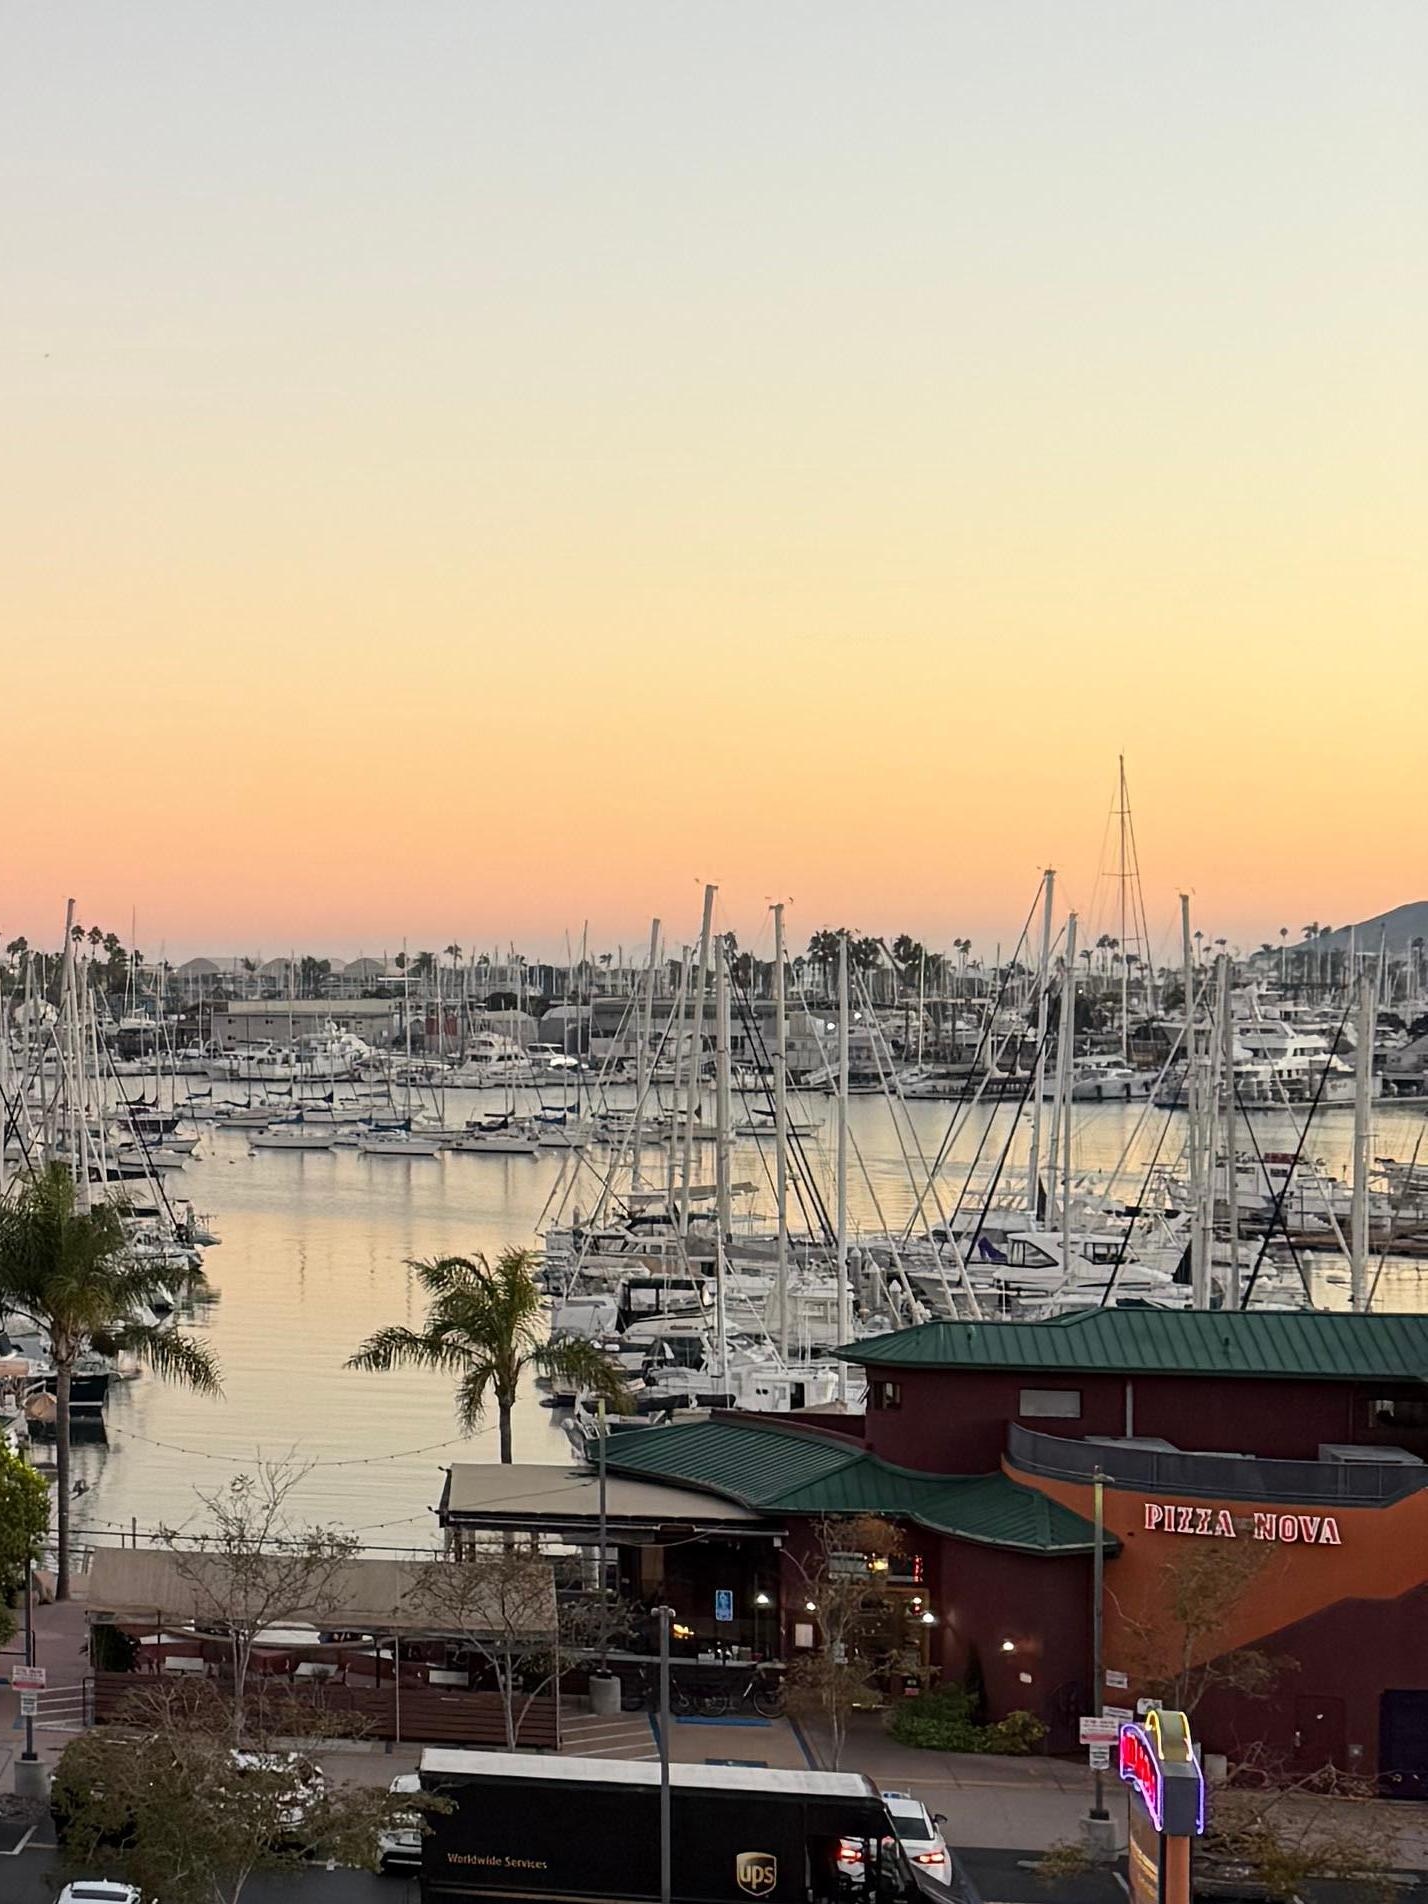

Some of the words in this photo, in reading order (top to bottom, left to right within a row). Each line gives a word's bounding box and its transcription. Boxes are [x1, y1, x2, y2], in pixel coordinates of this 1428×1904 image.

[1144, 1503, 1237, 1538] PIZZA
[1253, 1512, 1342, 1545] NOVA
[447, 1852, 502, 1867] Worldwide
[505, 1856, 547, 1870] Services
[740, 1863, 774, 1889] ups
